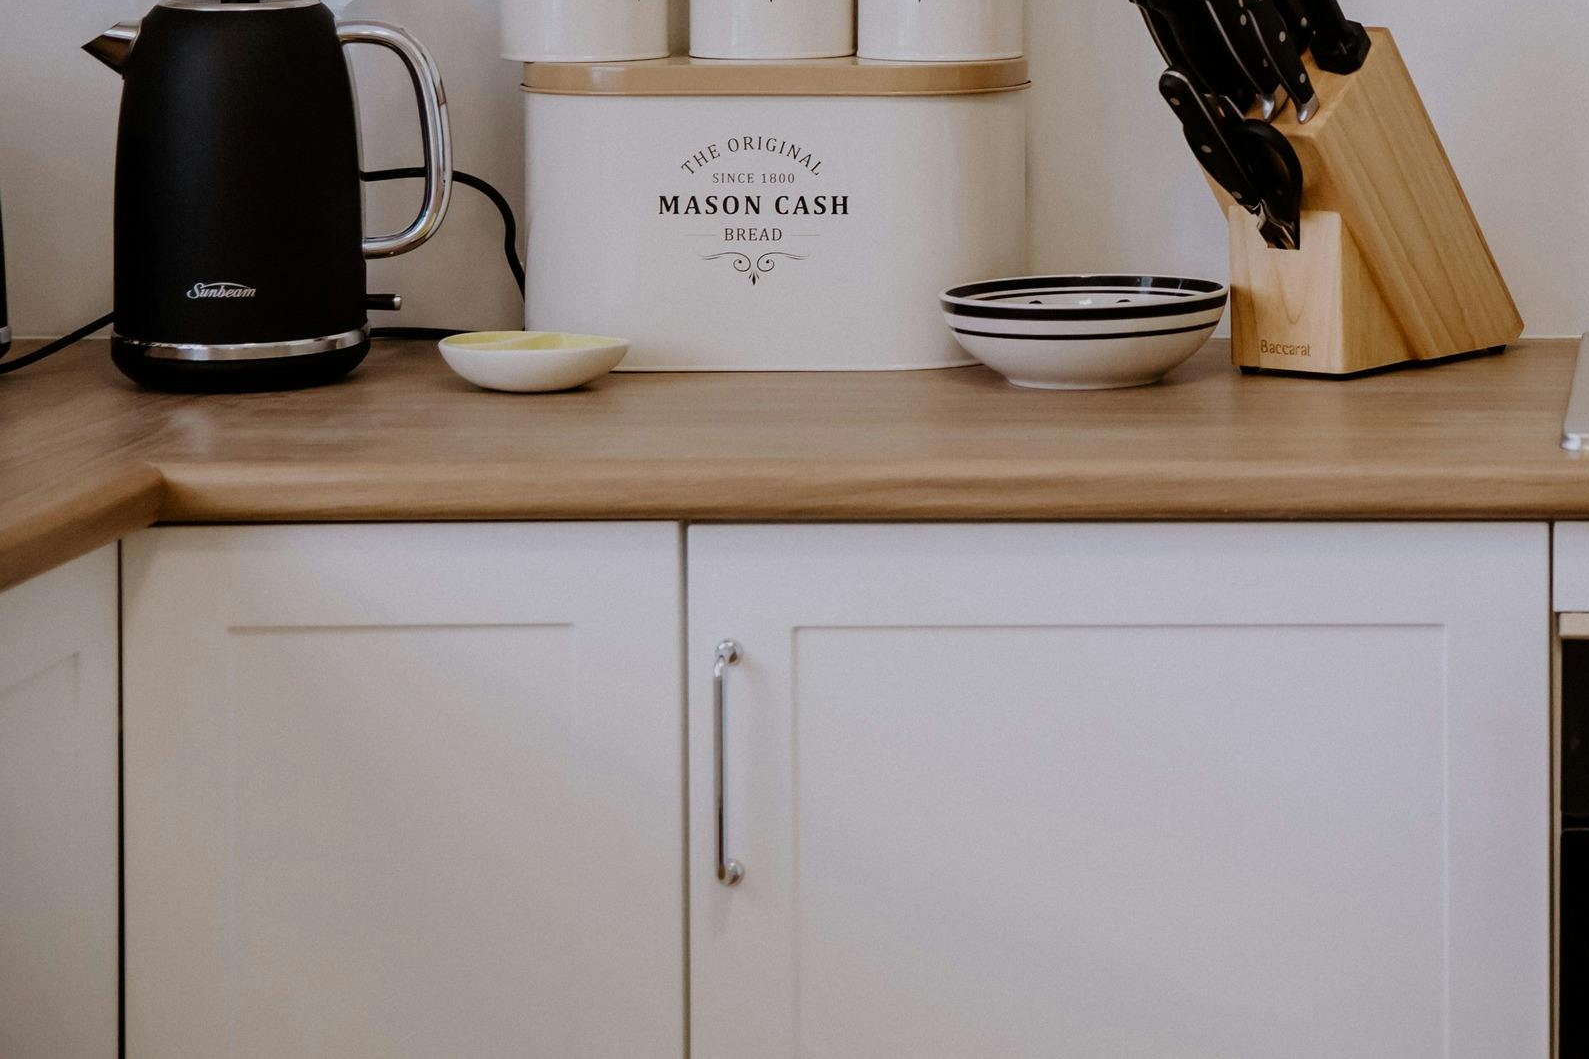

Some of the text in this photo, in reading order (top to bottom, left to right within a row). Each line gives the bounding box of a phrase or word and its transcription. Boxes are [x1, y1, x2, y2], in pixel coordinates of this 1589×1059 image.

[681, 136, 822, 176] THE ORIGINAL
[712, 173, 795, 184] SINCE 1800
[659, 195, 849, 215] MASON CASH
[725, 228, 783, 241] BREAD
[186, 282, 257, 299] Sunbeam
[1260, 339, 1312, 357] Baccarat
